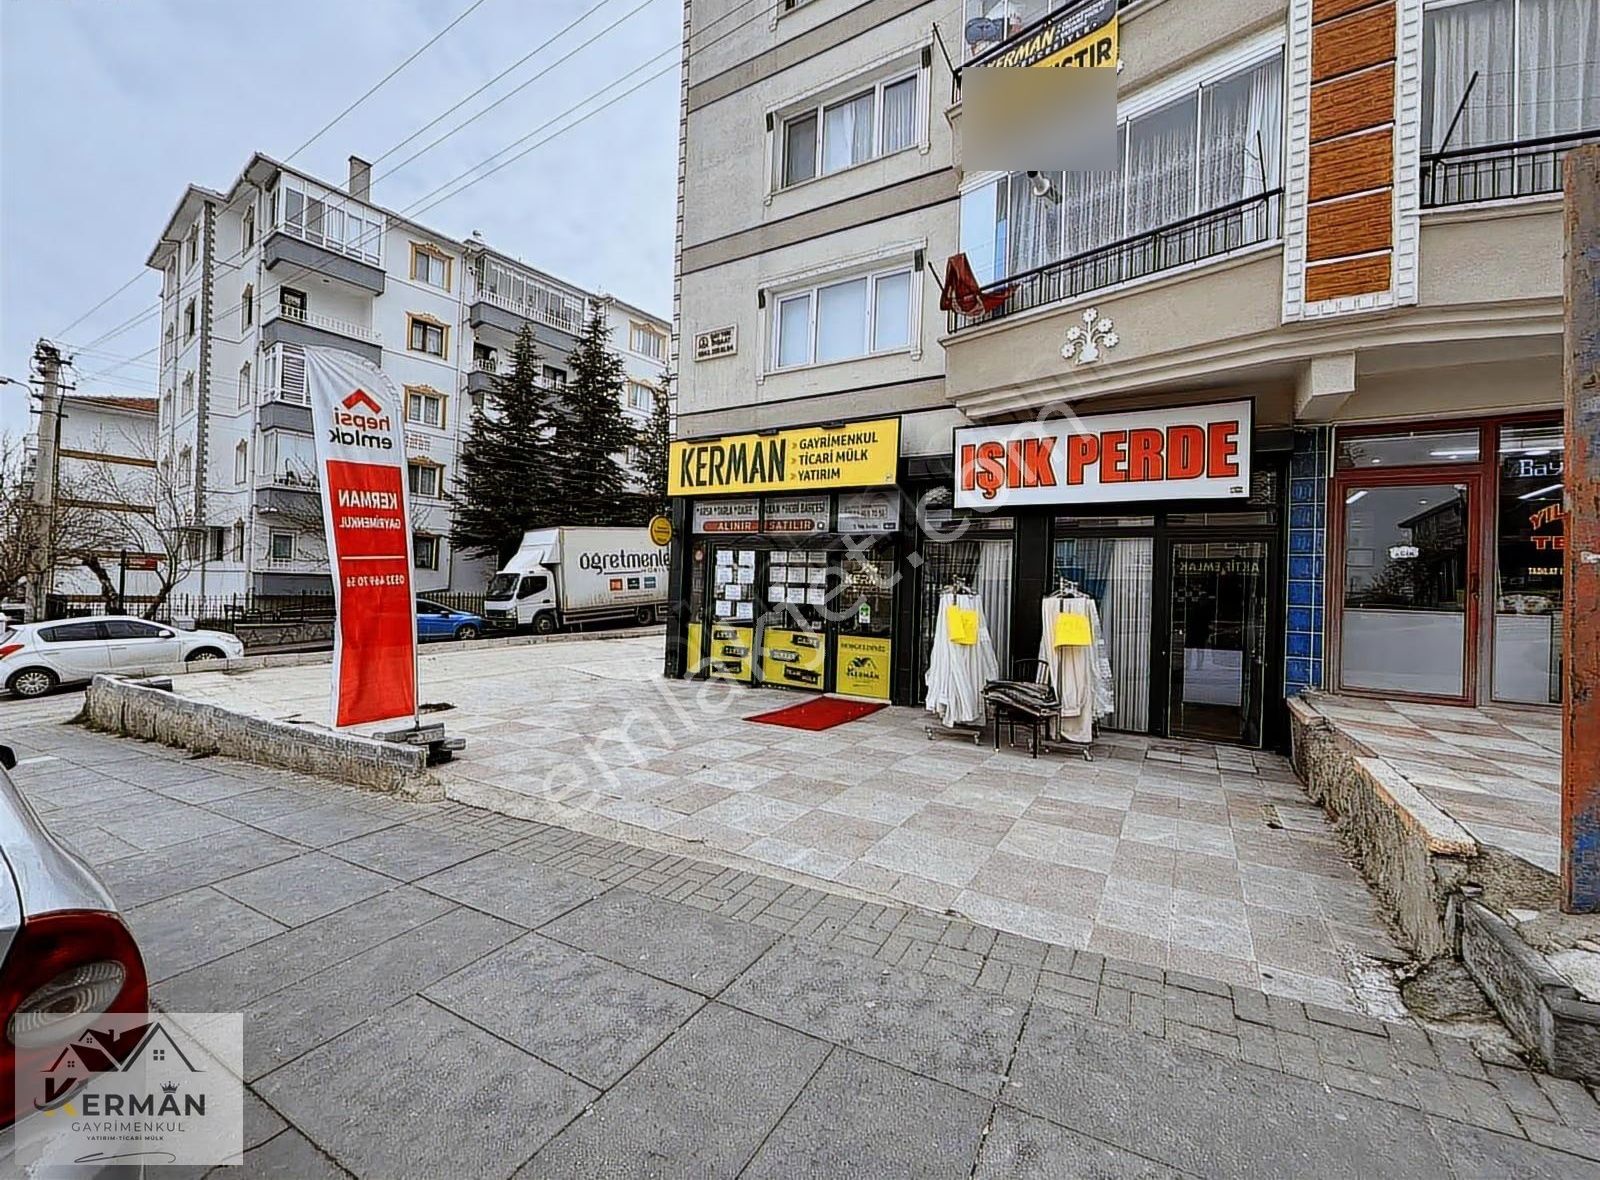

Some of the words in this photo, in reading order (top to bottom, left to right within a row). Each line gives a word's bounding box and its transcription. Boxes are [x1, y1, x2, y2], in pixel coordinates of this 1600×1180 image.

[799, 431, 878, 450] GAYRİMENKUL
[680, 438, 787, 488] KERMAN
[799, 450, 833, 466] TİCARİ
[836, 448, 868, 462] MÜLK
[961, 436, 1057, 499] IŞIK
[1067, 420, 1240, 486] PERDE
[798, 467, 840, 482] YATIRIM
[717, 521, 752, 531] ALINIR
[768, 520, 812, 530] SATILIR
